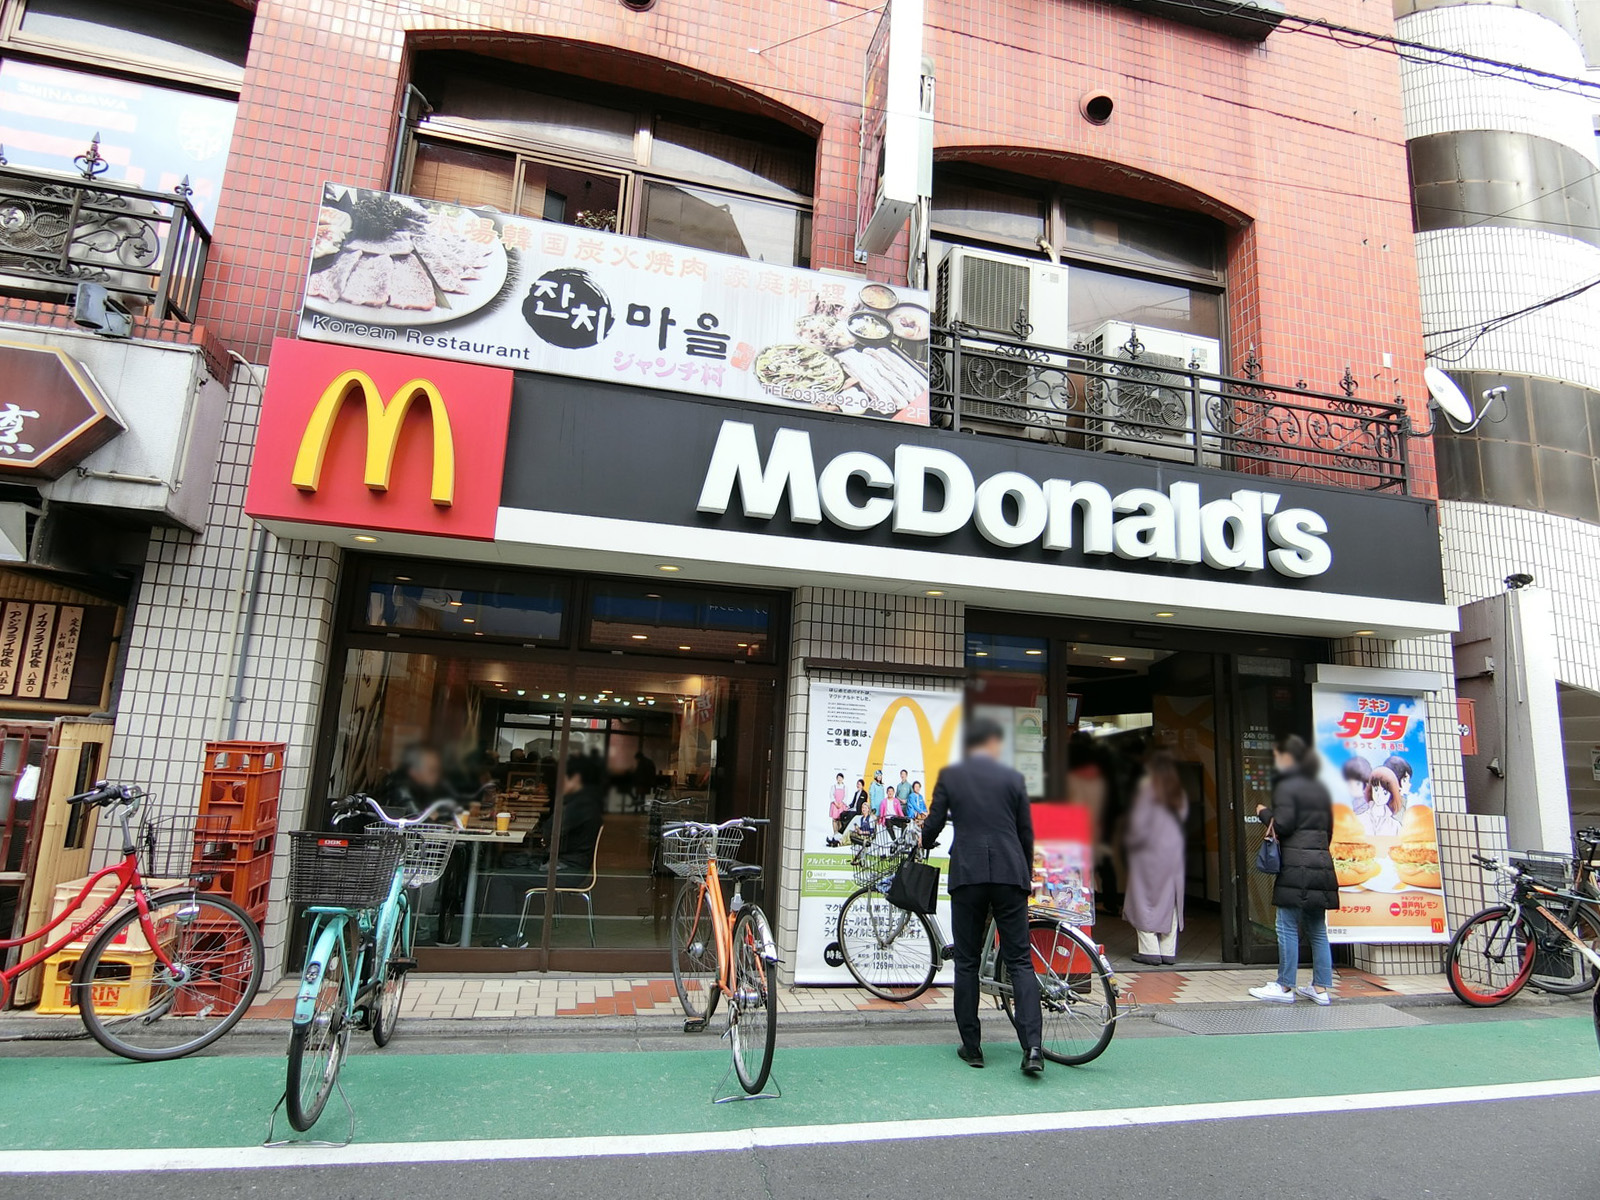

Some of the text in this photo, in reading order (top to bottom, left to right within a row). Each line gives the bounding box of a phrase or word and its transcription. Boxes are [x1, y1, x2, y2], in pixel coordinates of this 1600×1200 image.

[16, 81, 129, 111] SHINAGAWA
[533, 280, 608, 344] 잔치
[626, 303, 731, 360] 마을
[312, 315, 531, 361] Korean Restaurant
[613, 350, 727, 388] ジャンチ村
[906, 406, 928, 420] 2F
[697, 420, 1332, 578] McDonald's
[1358, 697, 1389, 712] チキン
[826, 727, 871, 739] この経験は、
[826, 738, 862, 747] 一生もの。
